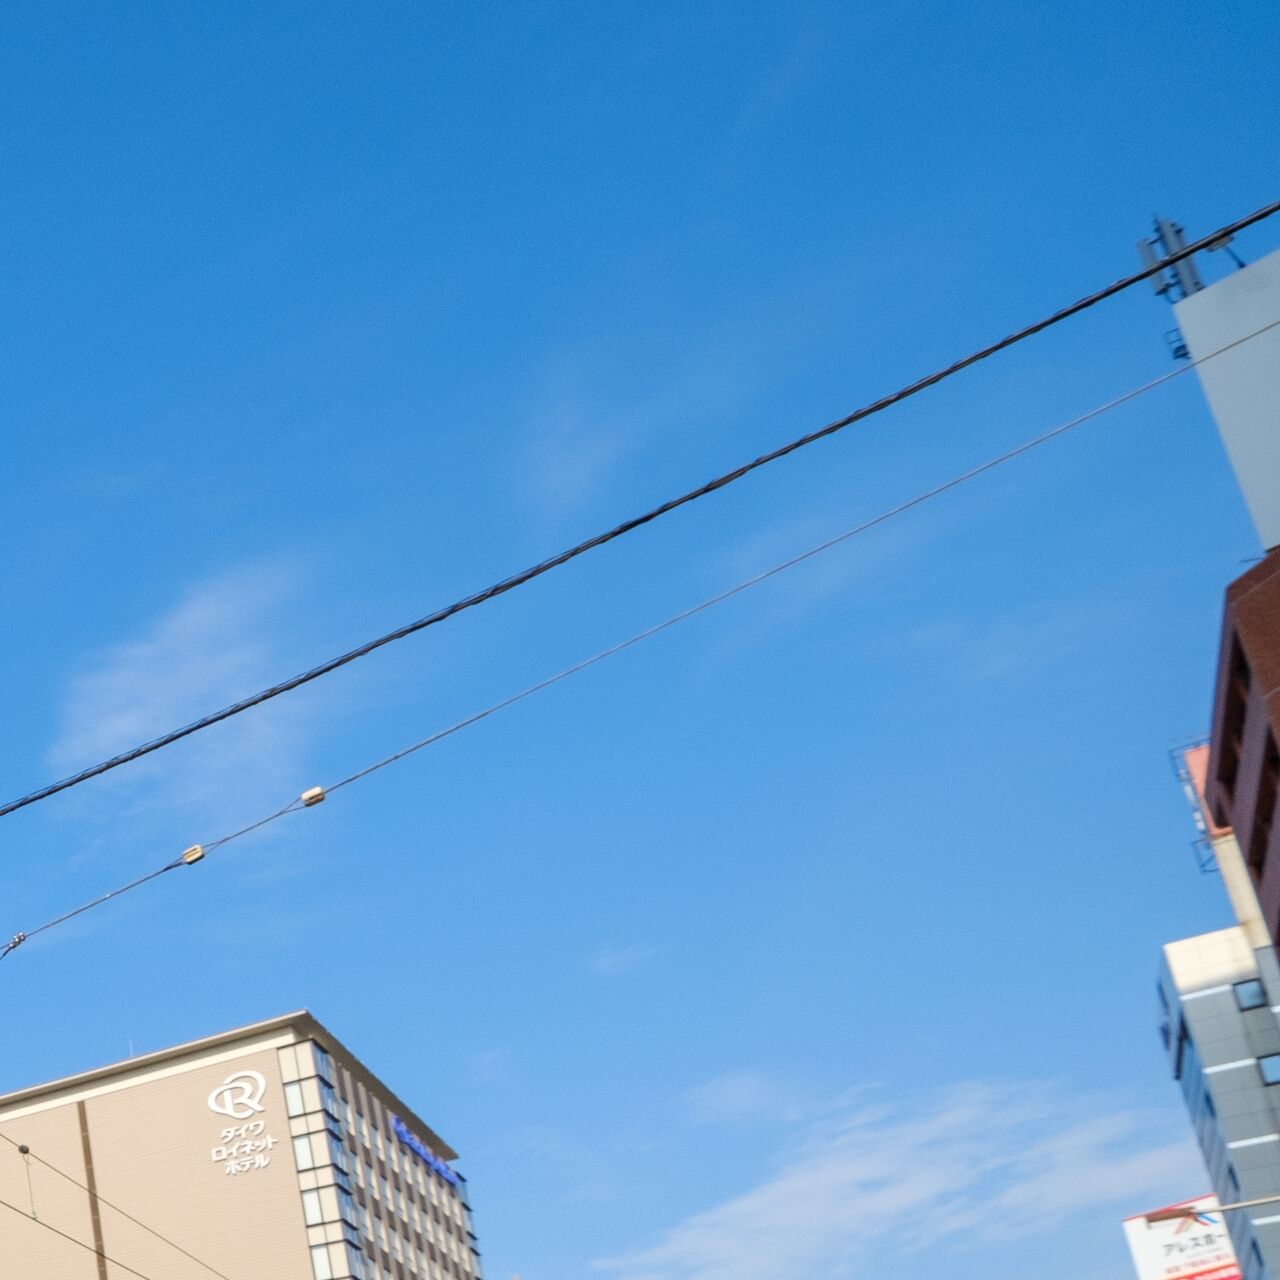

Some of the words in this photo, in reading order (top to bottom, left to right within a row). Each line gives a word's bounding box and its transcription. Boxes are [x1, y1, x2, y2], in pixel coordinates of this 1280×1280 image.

[220, 1120, 265, 1144] ダイワ
[211, 1135, 279, 1162] ロイネット
[225, 1154, 271, 1175] ホテル
